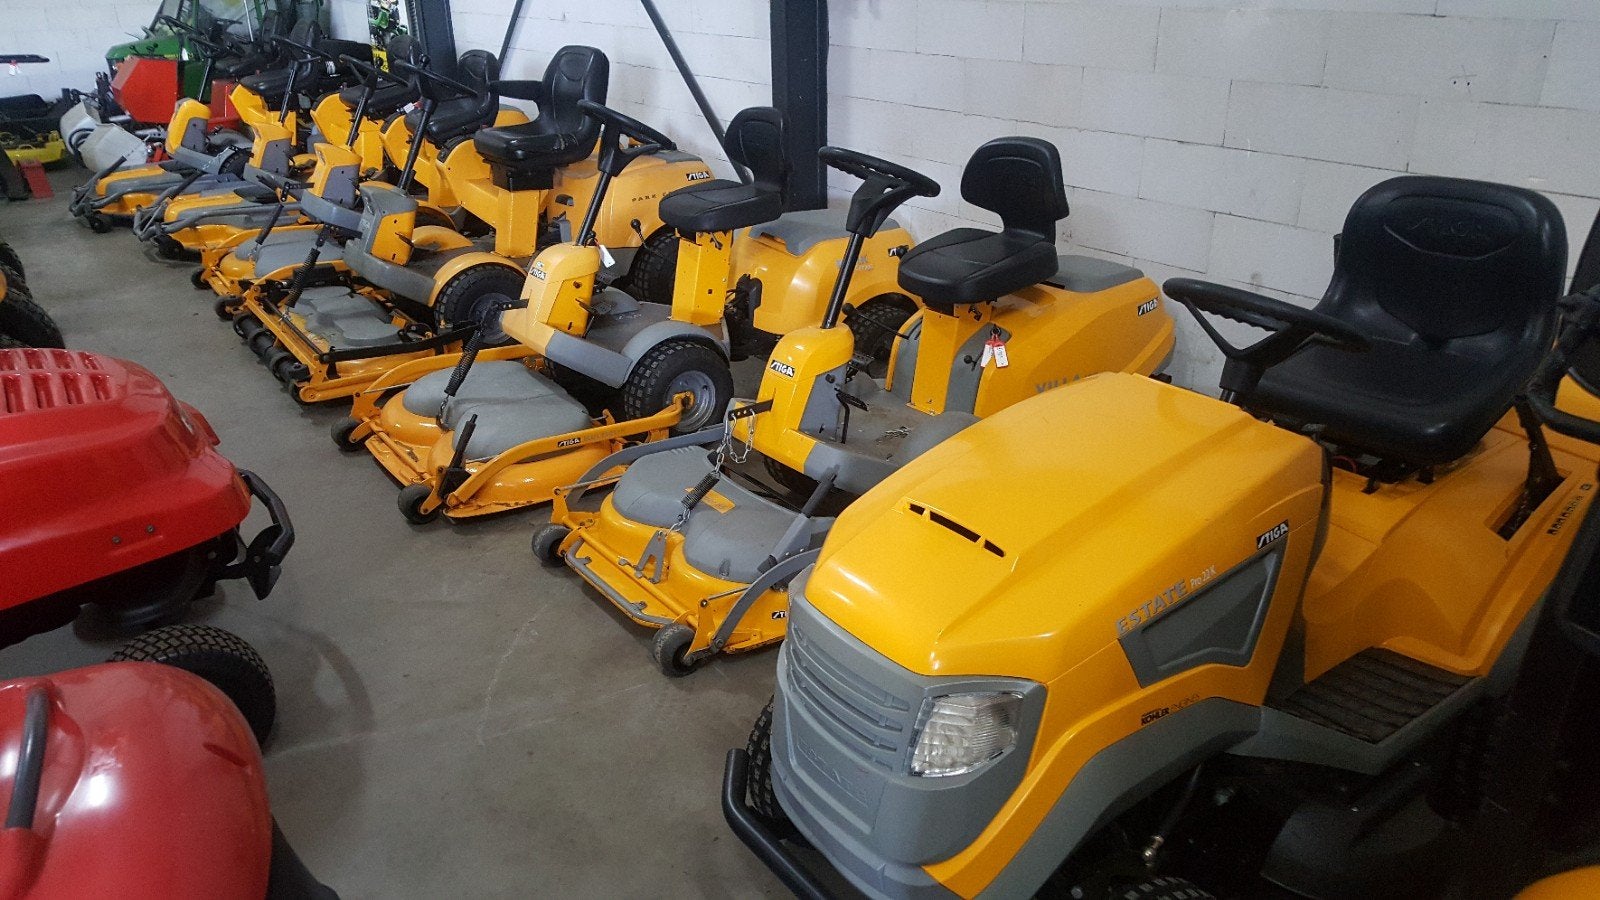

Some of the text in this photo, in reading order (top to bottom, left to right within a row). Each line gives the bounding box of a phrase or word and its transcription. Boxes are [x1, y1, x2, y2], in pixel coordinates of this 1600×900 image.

[687, 171, 710, 181] STIGA
[632, 194, 657, 202] PARK
[1138, 298, 1159, 316] STIGA
[770, 360, 794, 377] STIGA
[558, 438, 580, 447] STIGA
[1257, 519, 1289, 550] STIGA
[1116, 579, 1186, 634] ESTATE
